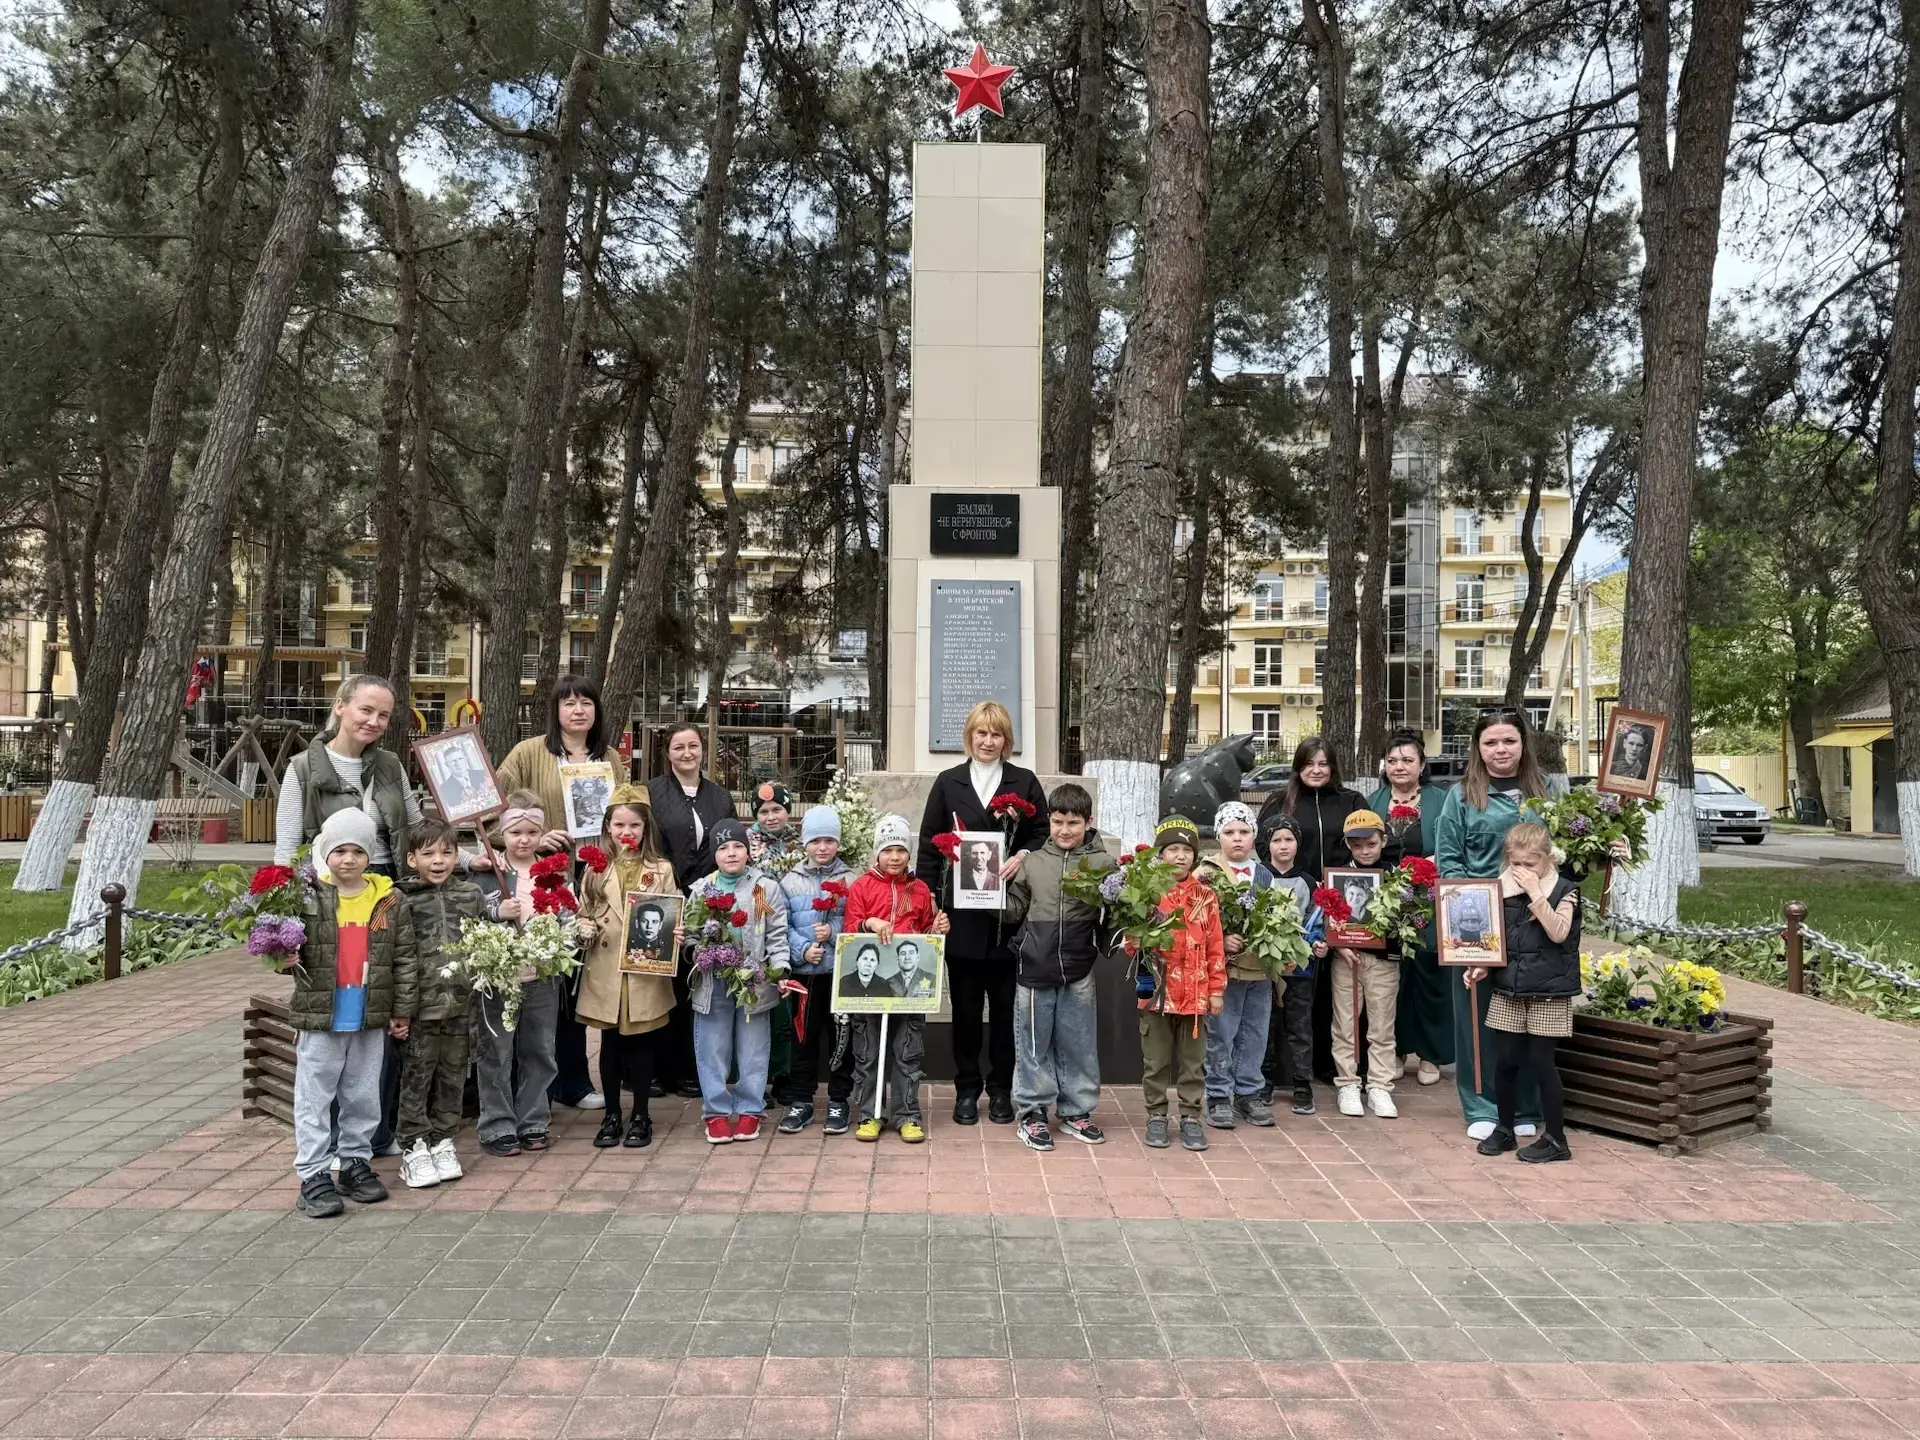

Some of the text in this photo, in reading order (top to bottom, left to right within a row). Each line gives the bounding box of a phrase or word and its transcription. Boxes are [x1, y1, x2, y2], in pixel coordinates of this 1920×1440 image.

[940, 516, 950, 527] НЕ
[952, 529, 997, 540] С ФРОНТОВ
